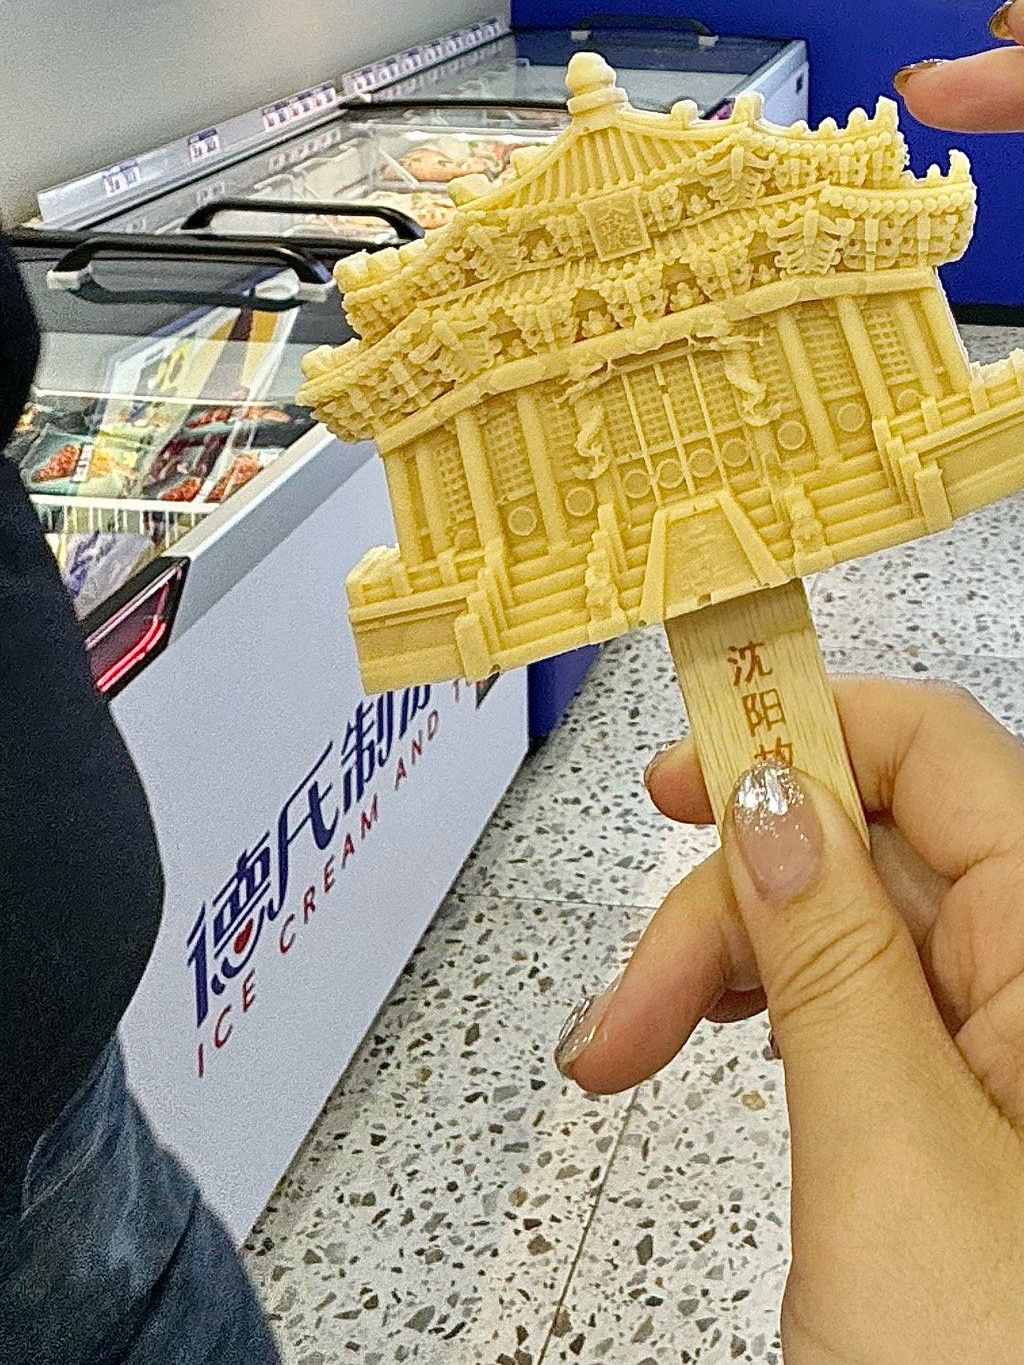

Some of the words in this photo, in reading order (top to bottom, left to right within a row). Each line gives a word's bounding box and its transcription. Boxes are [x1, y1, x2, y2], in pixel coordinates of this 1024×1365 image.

[197, 968, 256, 1078] ICE
[278, 792, 379, 955] CREAM
[394, 709, 439, 791] AND
